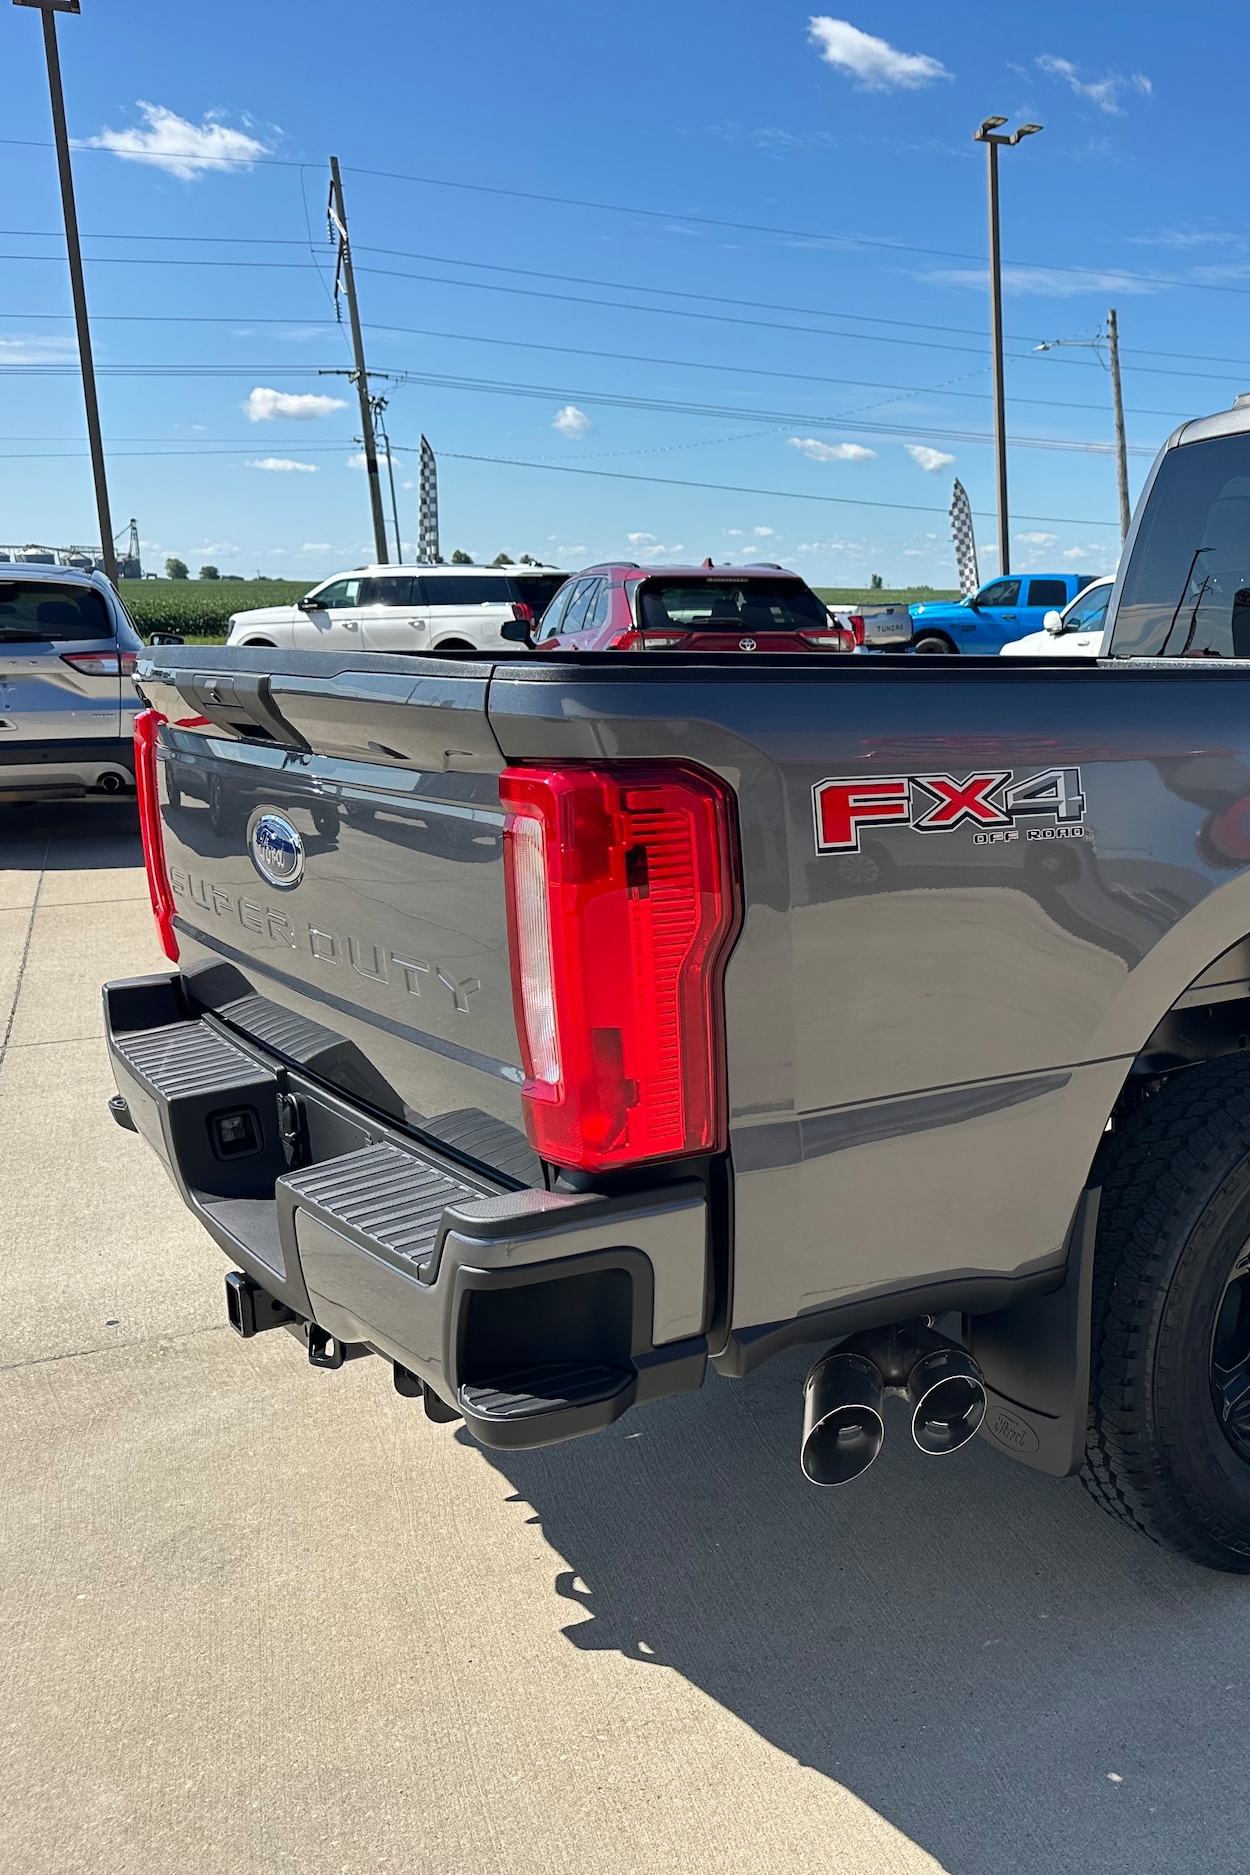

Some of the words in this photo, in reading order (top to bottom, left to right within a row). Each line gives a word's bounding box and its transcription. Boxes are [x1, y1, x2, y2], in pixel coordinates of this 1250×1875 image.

[877, 624, 904, 633] TUNDRA
[811, 767, 1087, 856] FX4
[258, 827, 285, 869] Ford
[973, 831, 1019, 845] OFF
[1026, 826, 1084, 841] ROAD
[170, 866, 296, 949] SUPER
[308, 922, 481, 1014] DUTY
[994, 1413, 1026, 1447] Ford
